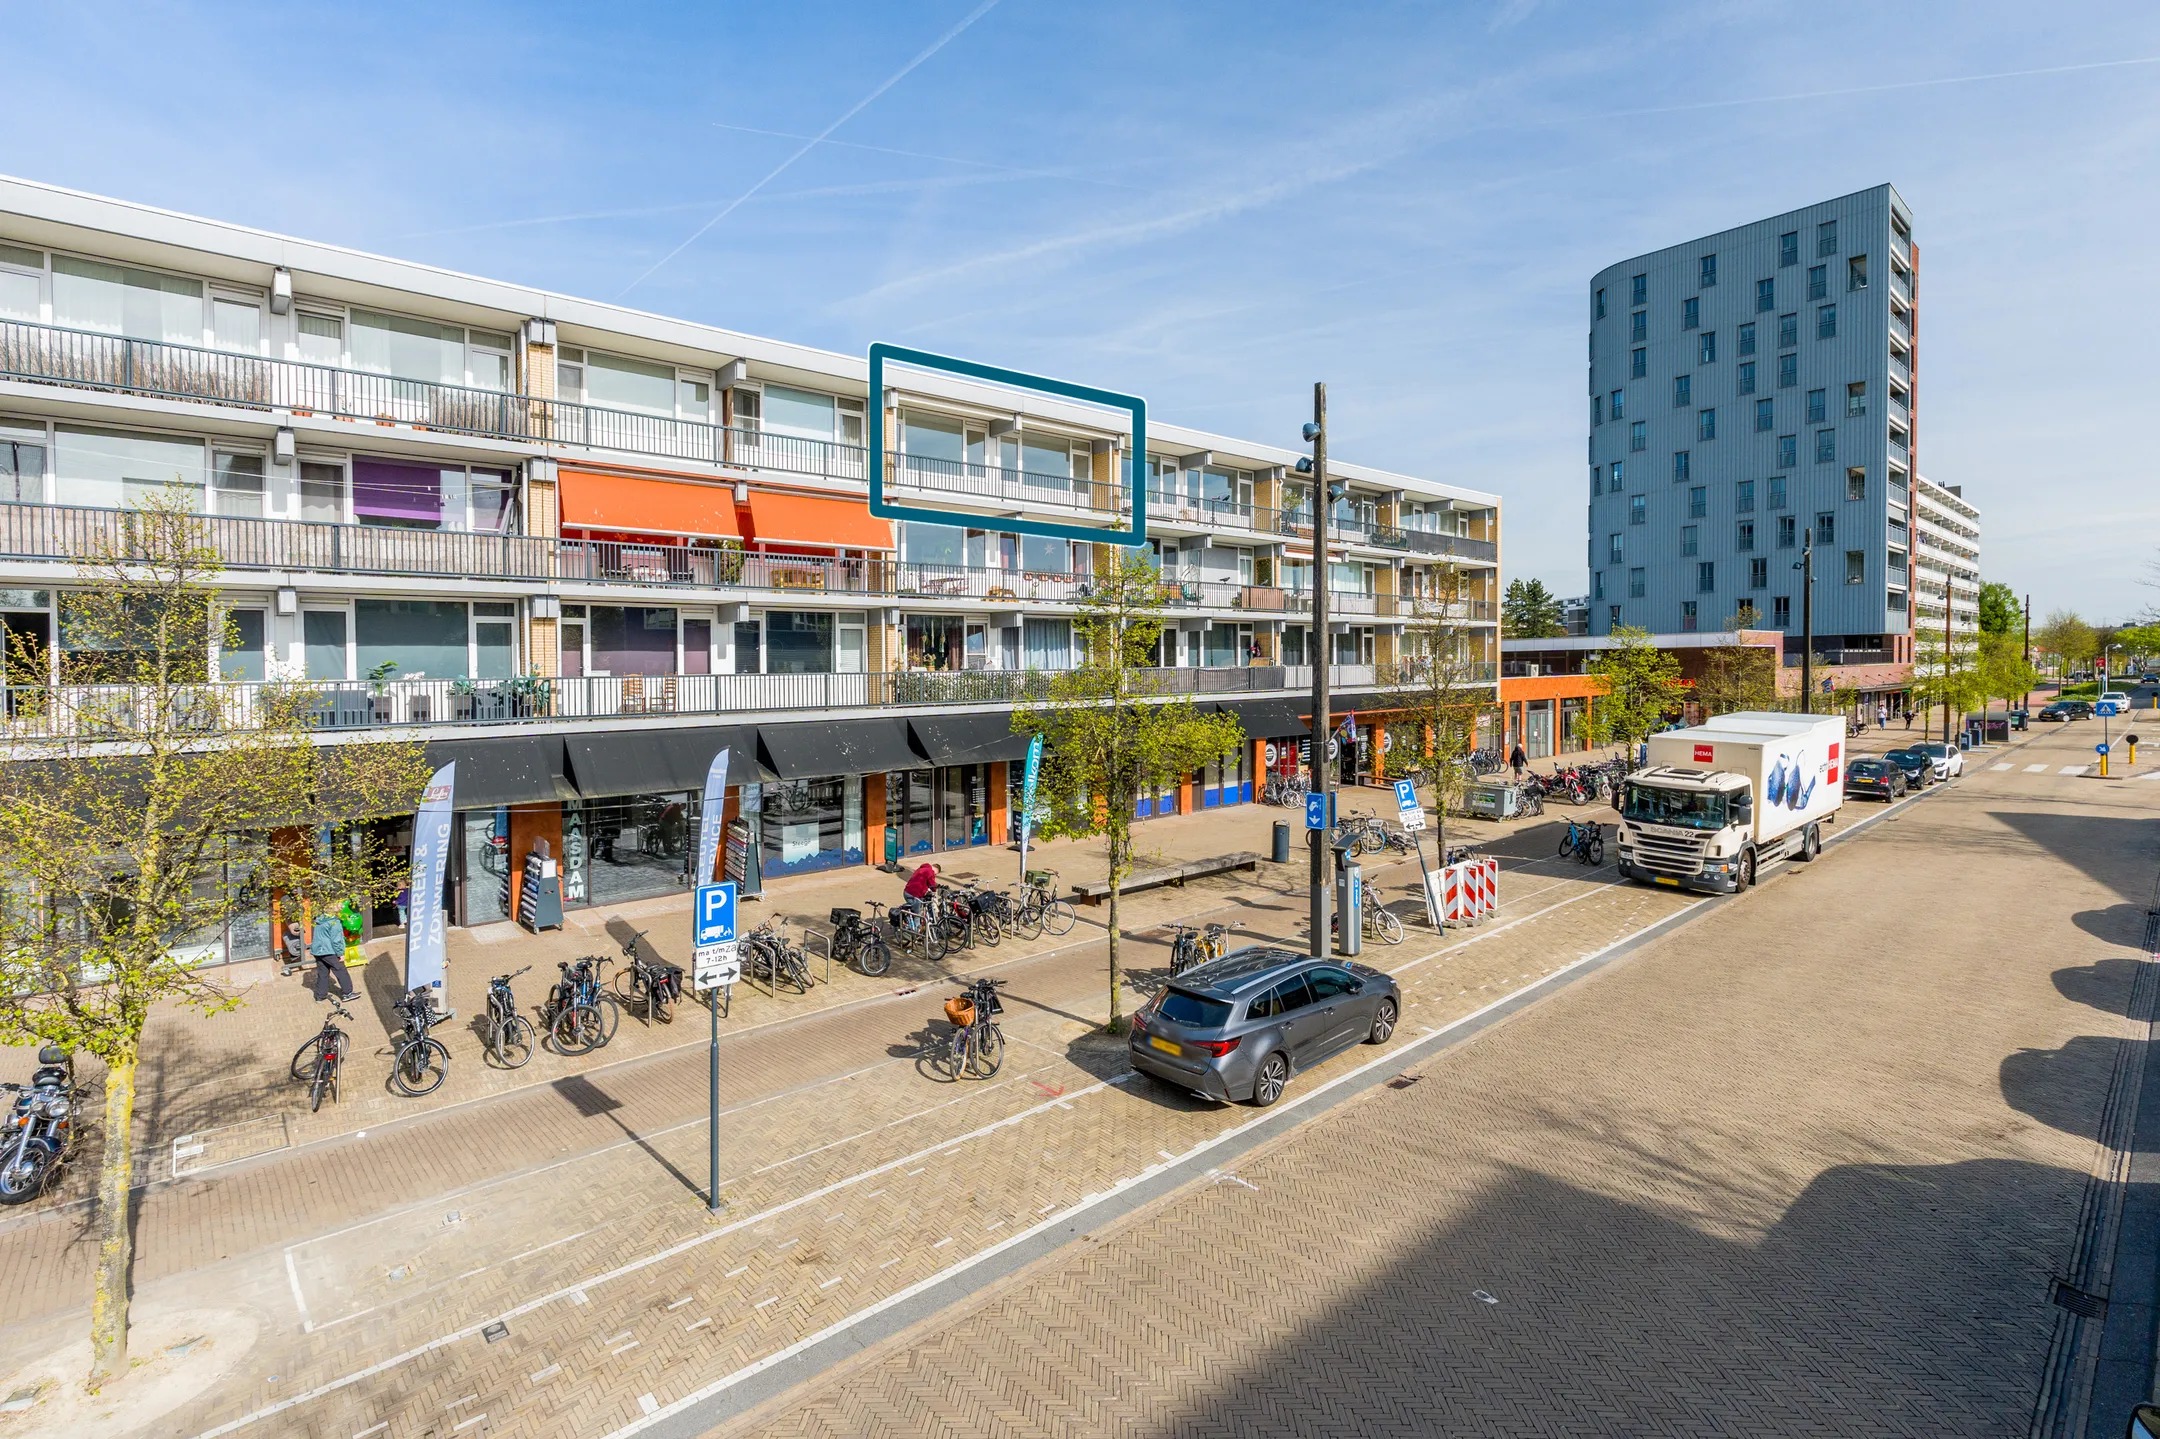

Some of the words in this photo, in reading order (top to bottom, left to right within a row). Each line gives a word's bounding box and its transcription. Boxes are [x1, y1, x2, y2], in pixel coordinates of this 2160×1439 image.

[1399, 783, 1410, 799] P
[1650, 826, 1684, 836] SCANIA
[1684, 830, 1694, 838] 22
[414, 843, 428, 857] &
[567, 799, 584, 899] MAASDAM
[427, 823, 450, 946] ZONWERING
[705, 889, 727, 921] P
[705, 955, 728, 964] 7-12h
